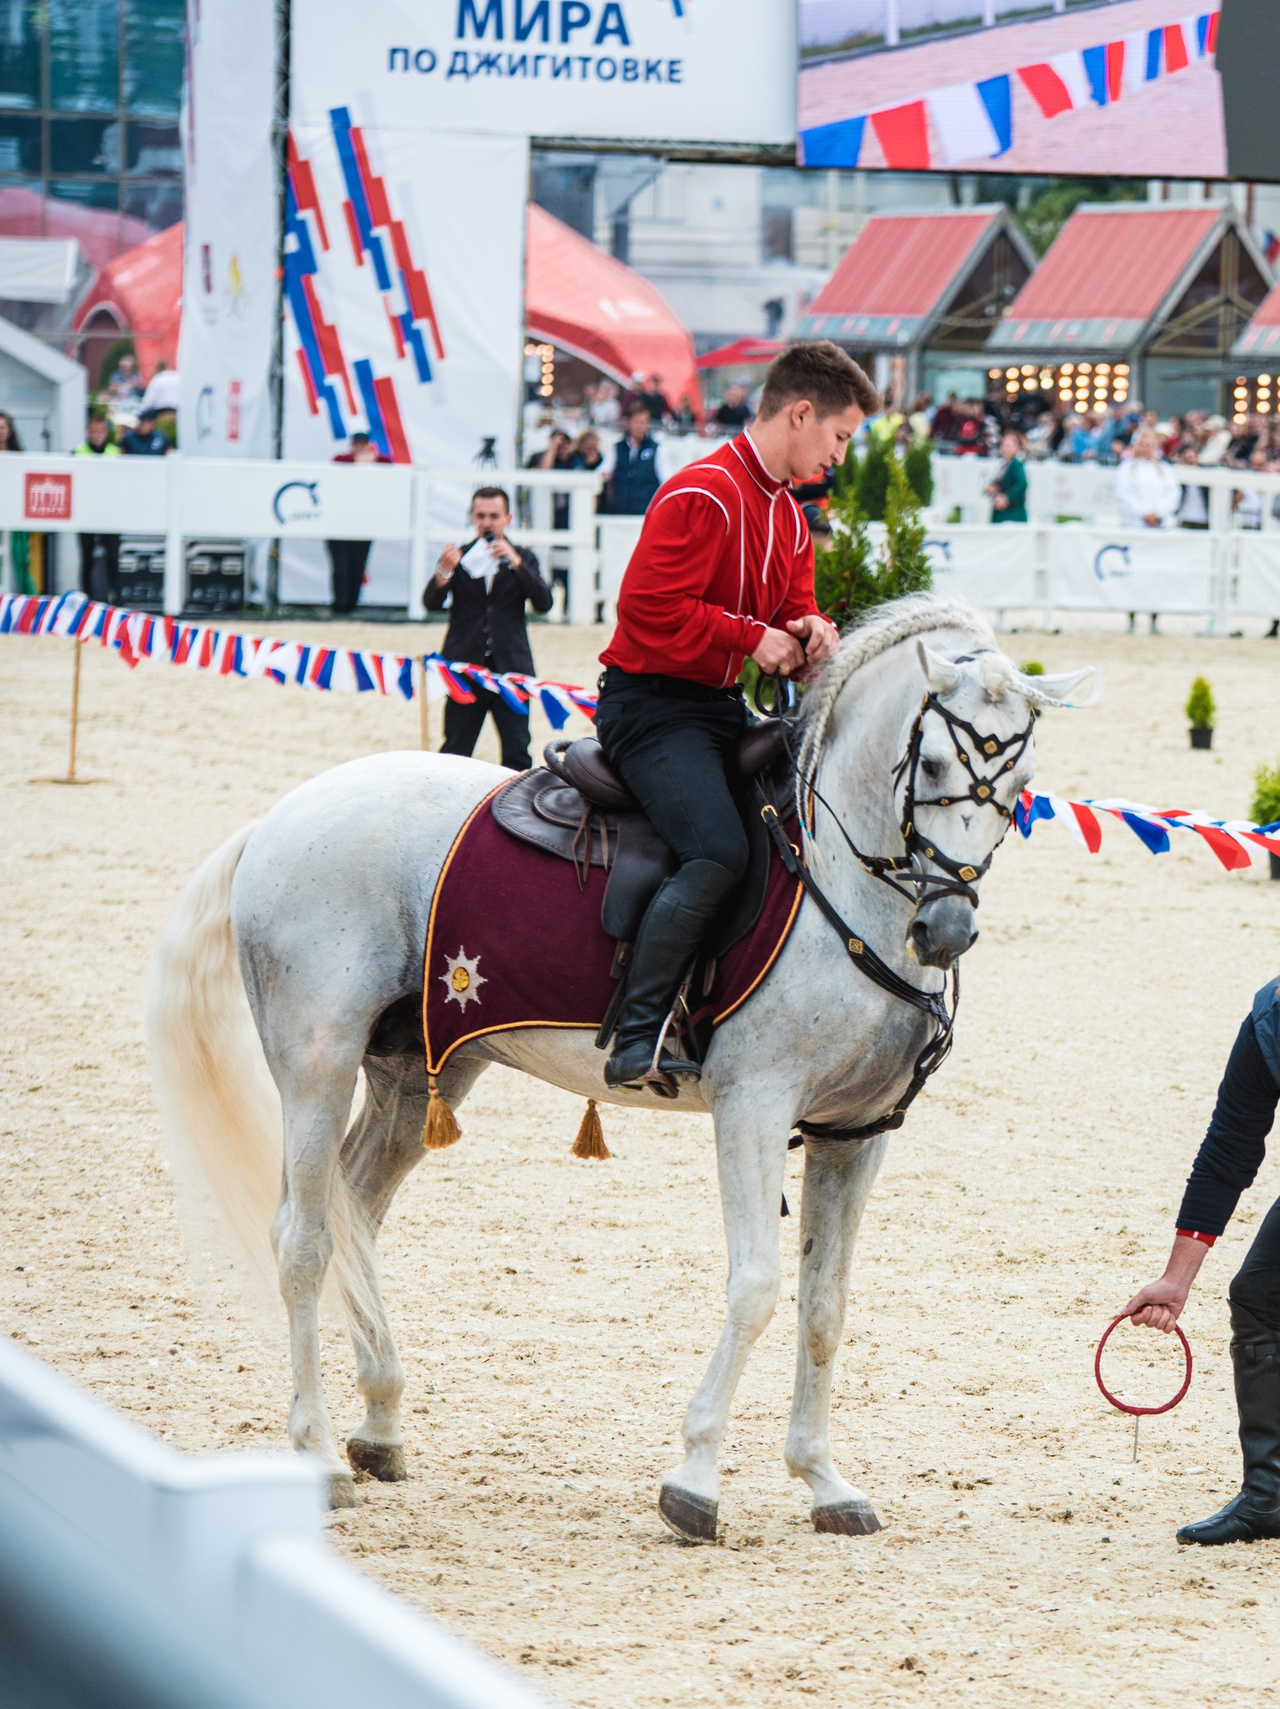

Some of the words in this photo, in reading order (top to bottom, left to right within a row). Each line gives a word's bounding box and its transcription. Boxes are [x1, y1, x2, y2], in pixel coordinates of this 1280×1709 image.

[456, 0, 631, 46] МИРА
[388, 48, 437, 73] ПО
[446, 51, 683, 83] ДЖИГИТОВКЕ
